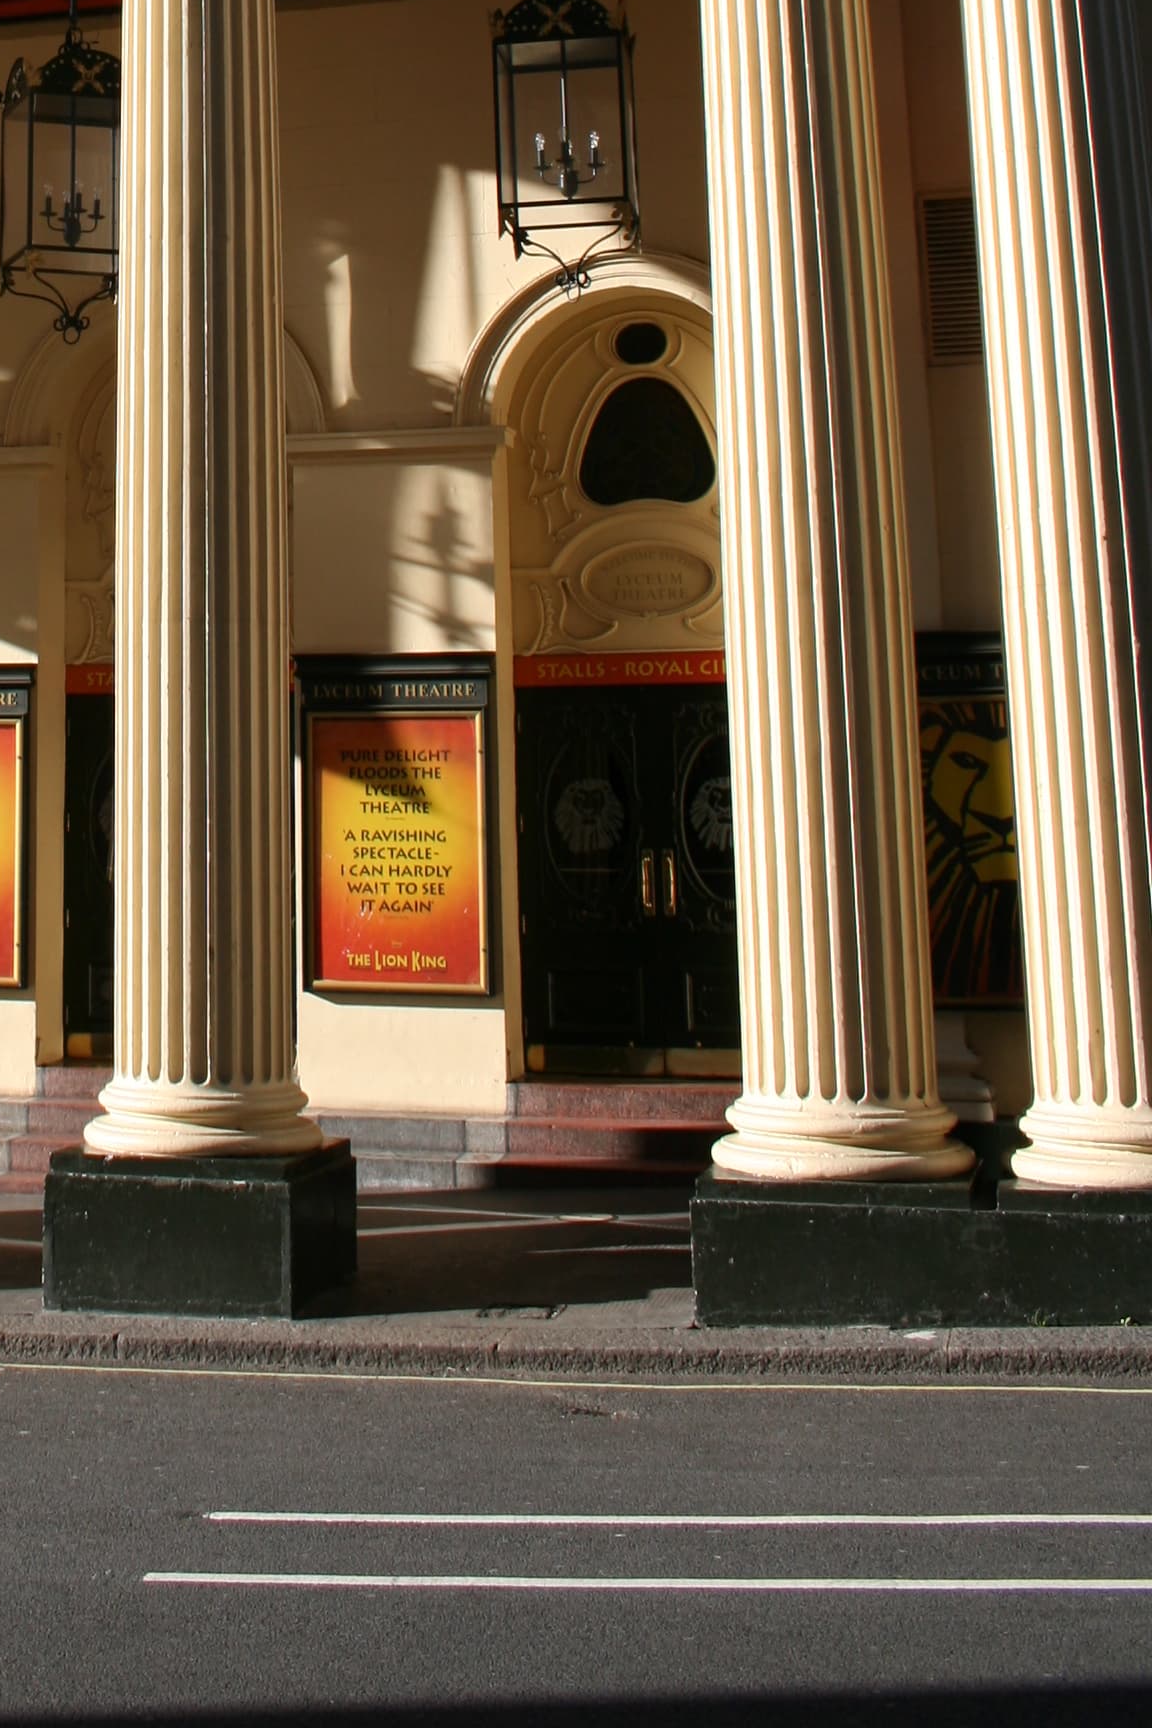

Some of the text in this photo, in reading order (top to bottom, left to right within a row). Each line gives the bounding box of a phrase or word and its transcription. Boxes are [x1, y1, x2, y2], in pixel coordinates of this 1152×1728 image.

[537, 661, 605, 680] STALLS
[625, 660, 694, 678] ROYAL
[312, 682, 477, 699] LYCEUM THEATRE
[384, 749, 451, 762] DELIGHT
[348, 766, 441, 780] FLOODS THE
[365, 783, 426, 797] LYCEUM
[361, 829, 447, 843] RAVISHING
[349, 864, 384, 877] CAN
[388, 864, 453, 878] HARDLY
[347, 882, 446, 896] WAIT TO SEE
[361, 899, 376, 913] IT
[347, 950, 447, 973] THE LION KING
